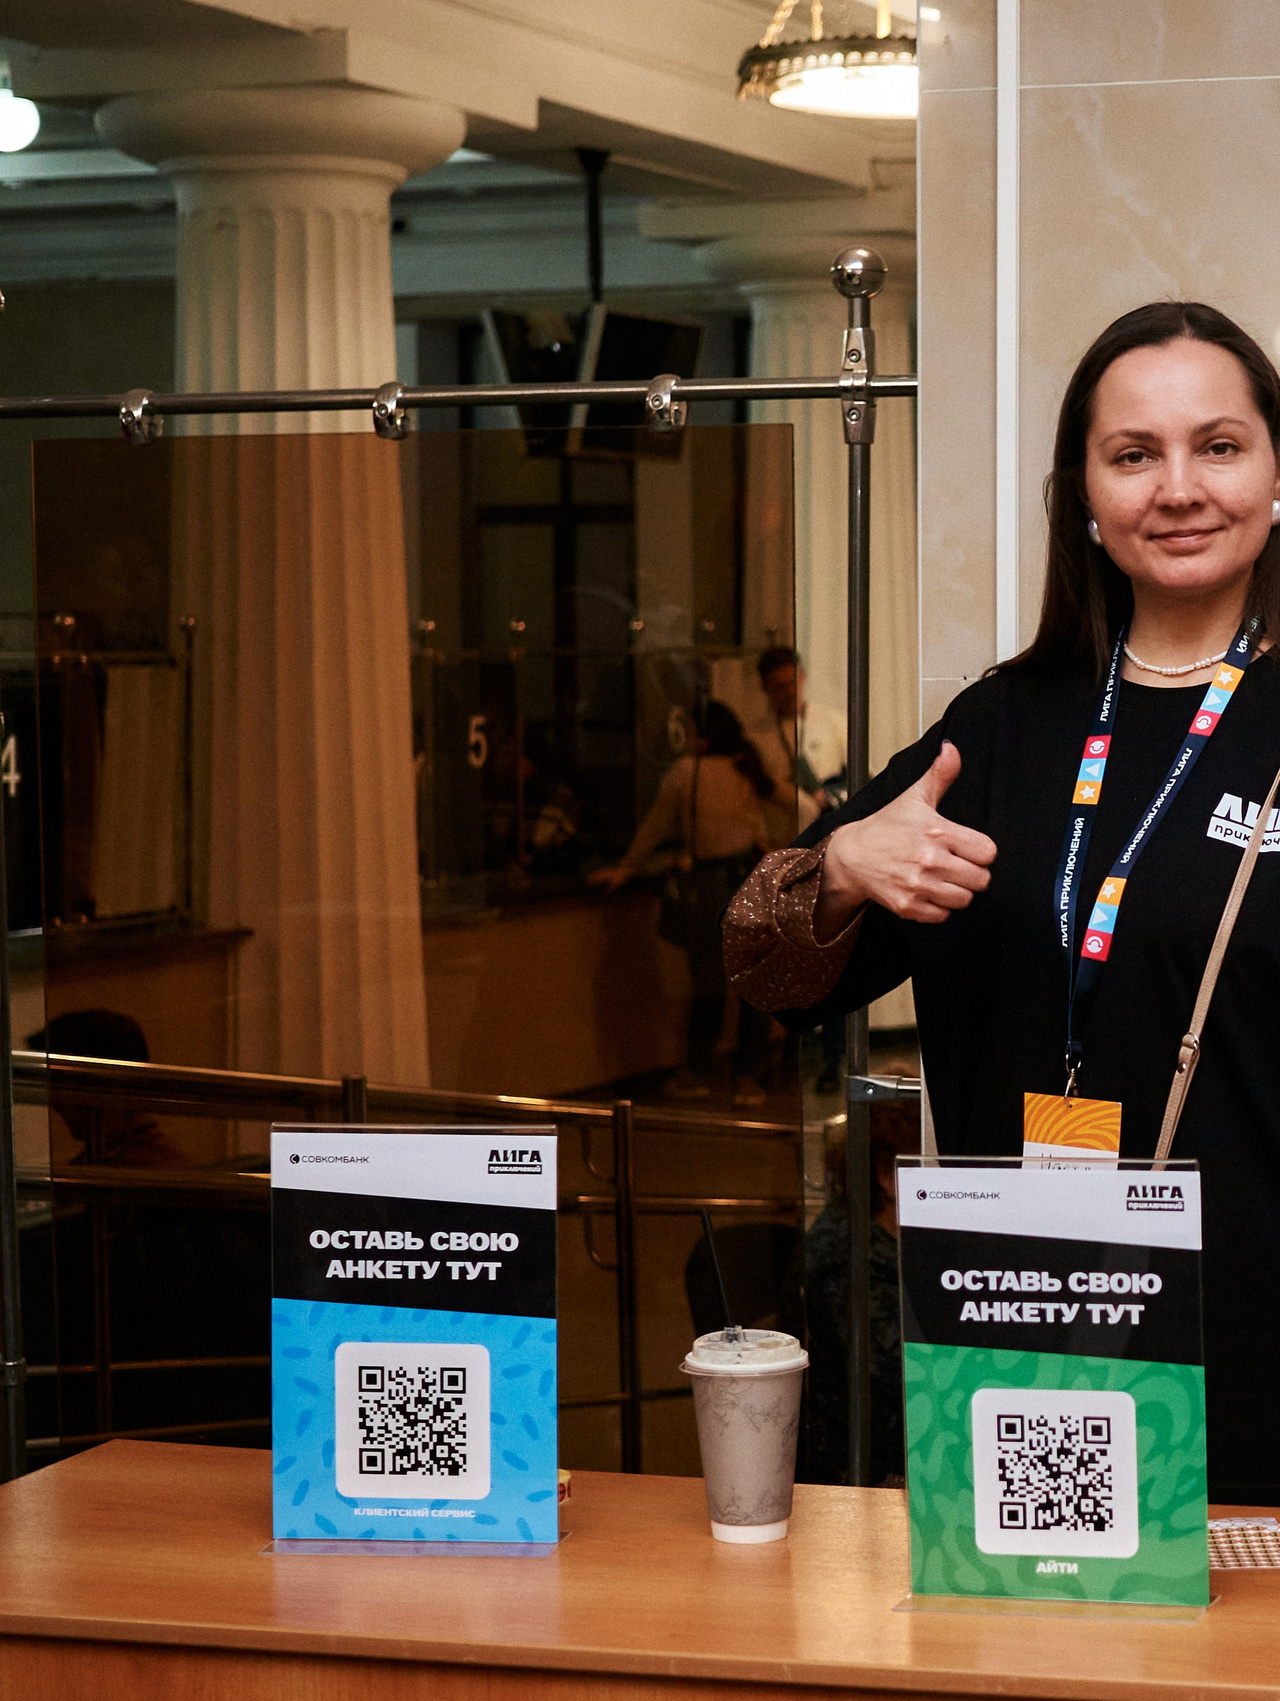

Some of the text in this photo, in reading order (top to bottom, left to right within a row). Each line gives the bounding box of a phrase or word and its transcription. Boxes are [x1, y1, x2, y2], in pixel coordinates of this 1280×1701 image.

[1100, 693, 1112, 722] ЛИГА
[667, 704, 686, 752] 6
[468, 714, 488, 769] 5
[1, 734, 21, 797] 4
[1120, 748, 1193, 864] ЛИГА ПРИКЛЮЧЕНИЙ
[1061, 817, 1085, 910] ПРИКЛЮЧЕНИЙ
[301, 1155, 370, 1164] СОВКОМБАНК
[488, 1150, 542, 1163] ЛИГА
[929, 1191, 1001, 1200] СОВКОМБАНК
[1126, 1185, 1184, 1199] ЛИГА
[309, 1230, 519, 1252] ОСТАВЬ СВОЮ
[326, 1259, 502, 1281] АНКЕТУ ТУТ
[941, 1269, 1163, 1294] ОСТАВЬ СВОЮ
[960, 1301, 1145, 1325] АНКЕТУ ТУТ
[354, 1507, 476, 1518] КЛИЕНТСКИЙ СЕРВИС
[1036, 1559, 1078, 1575] АЙТИ
